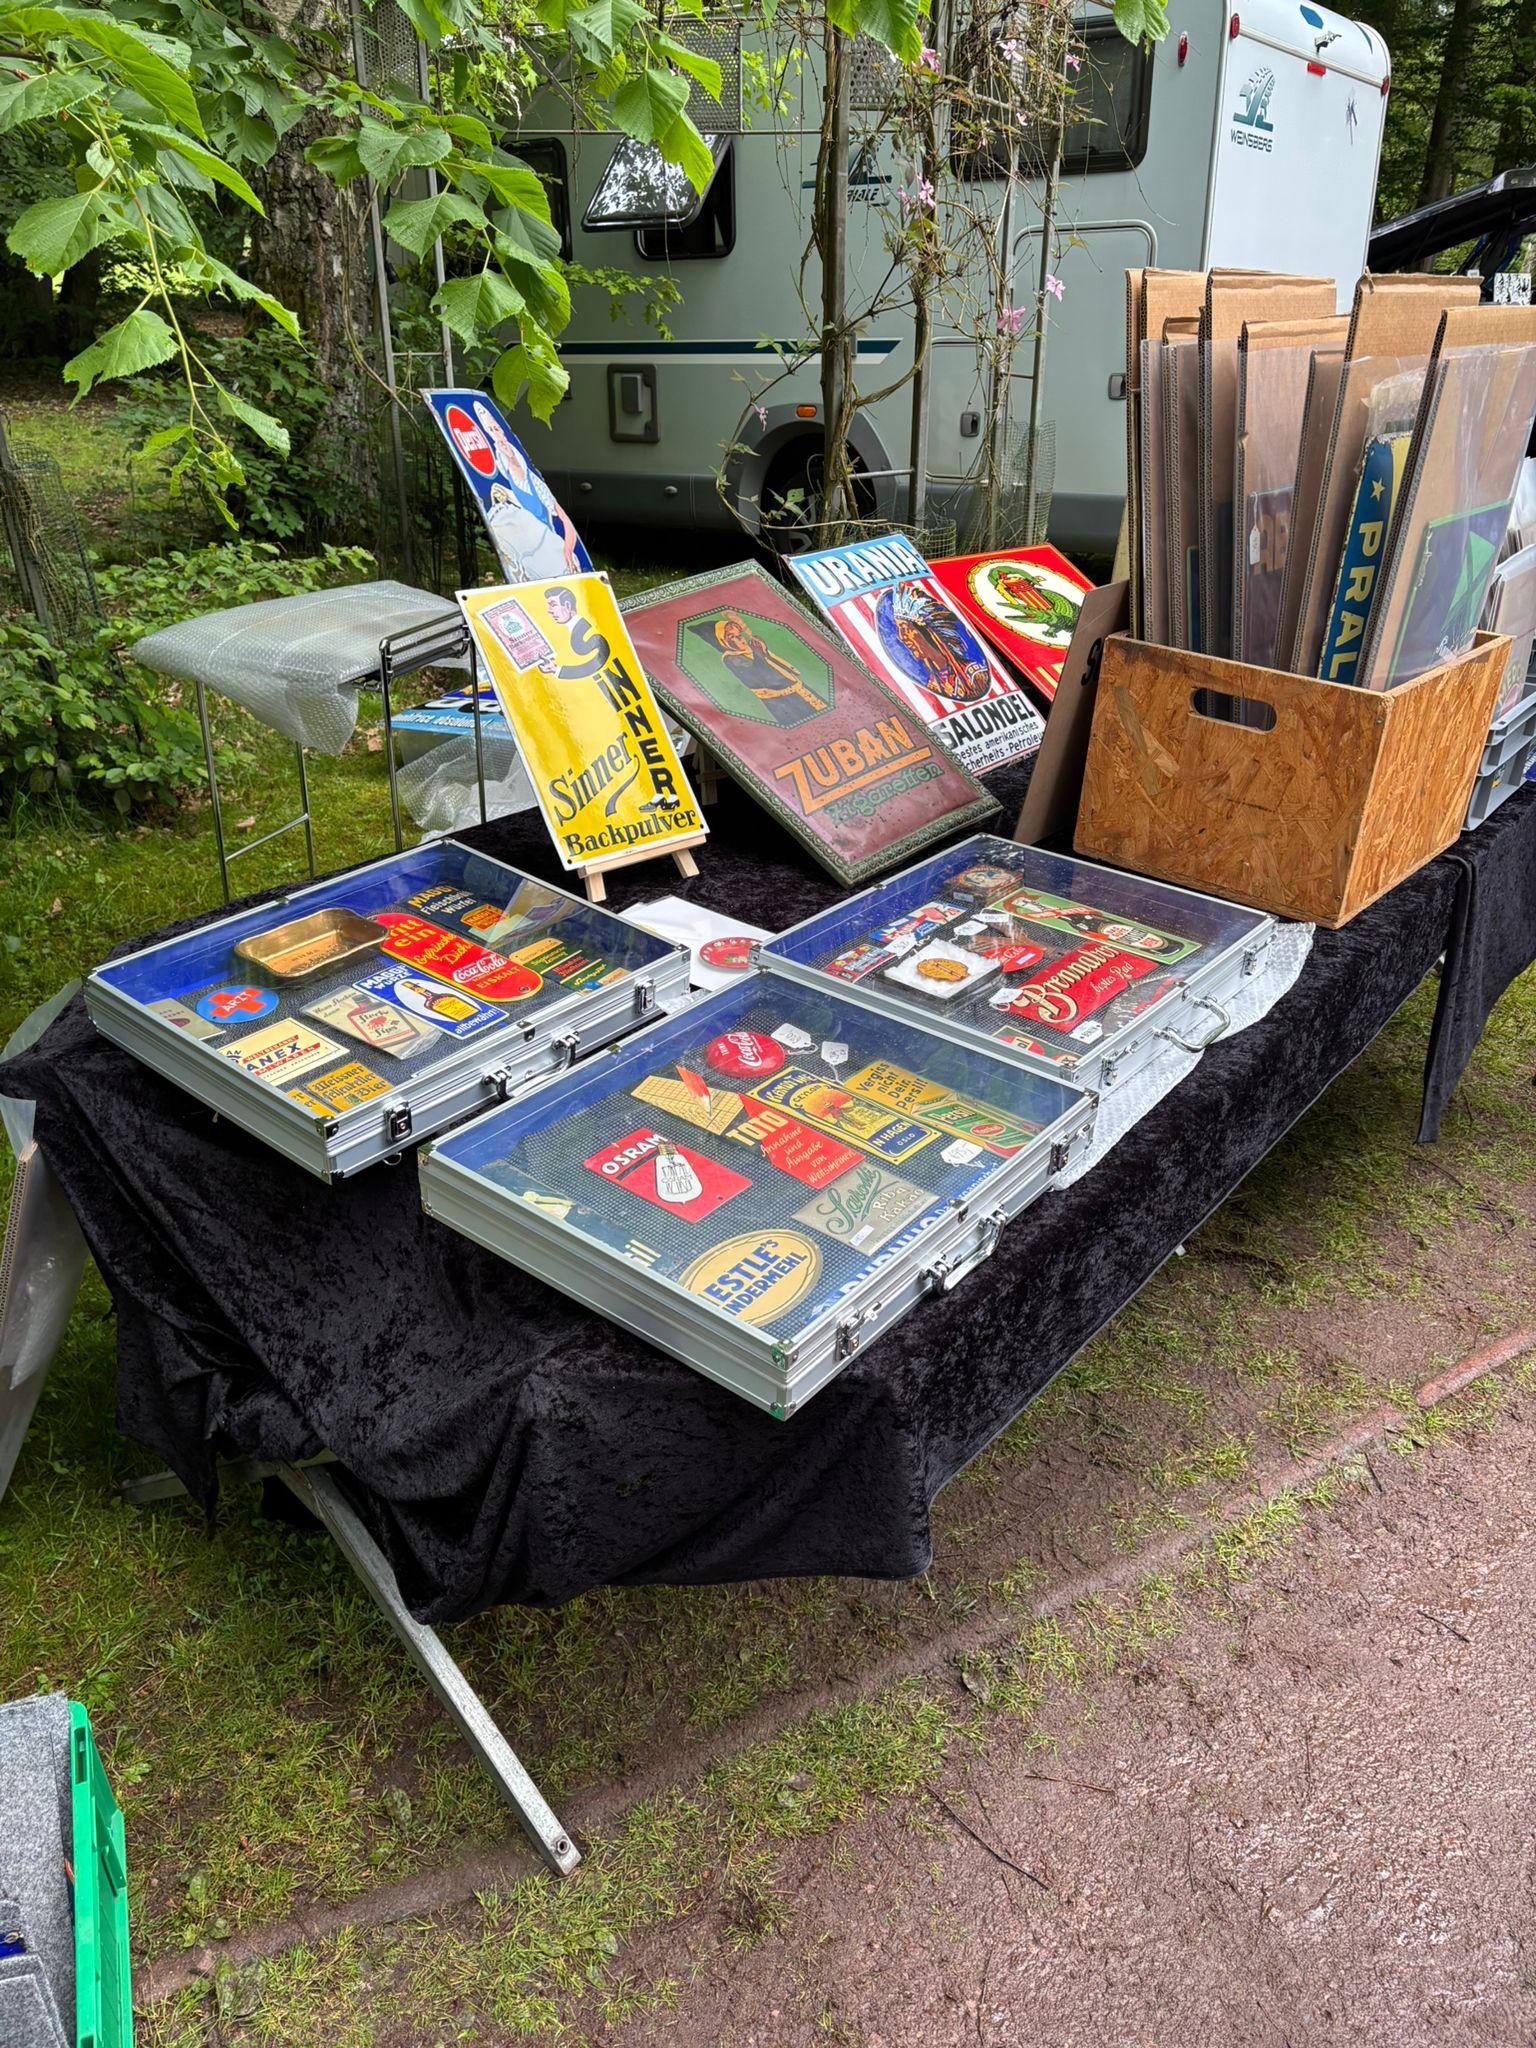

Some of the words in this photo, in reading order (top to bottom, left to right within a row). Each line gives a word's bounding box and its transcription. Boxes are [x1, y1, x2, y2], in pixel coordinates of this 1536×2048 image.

[1231, 128, 1273, 153] WEINSBERG
[801, 541, 929, 598] URANIA
[933, 693, 1036, 750] SALONOEL
[985, 721, 1039, 749] amerikanisches
[549, 731, 632, 827] Sinner
[772, 715, 932, 817] ZUBAN
[824, 762, 945, 826] Zigaretten
[563, 810, 696, 857] Backpulver
[394, 928, 437, 947] ein
[413, 933, 457, 965] Erfrische
[453, 953, 508, 983] Coca-Cola
[476, 967, 521, 989] EISKALT
[1090, 975, 1116, 993] bestes
[1110, 960, 1135, 981] Rad
[1013, 945, 1120, 1023] Brennabor
[222, 991, 252, 1012] ARZT
[856, 1063, 890, 1092] Vergiss
[877, 1071, 899, 1093] nicht
[888, 1077, 912, 1101] Dein
[896, 1077, 930, 1110] Persil!
[725, 1110, 790, 1147] TOTO
[761, 1127, 803, 1157] Annahme
[881, 1120, 913, 1141] HAGEN
[897, 1133, 916, 1146] OSLO
[601, 1133, 668, 1174] OSRAM
[785, 1140, 804, 1156] und
[785, 1141, 824, 1169] Ausgabe
[810, 1155, 828, 1168] von
[873, 1186, 907, 1210] Riba
[880, 1188, 925, 1222] Kakao
